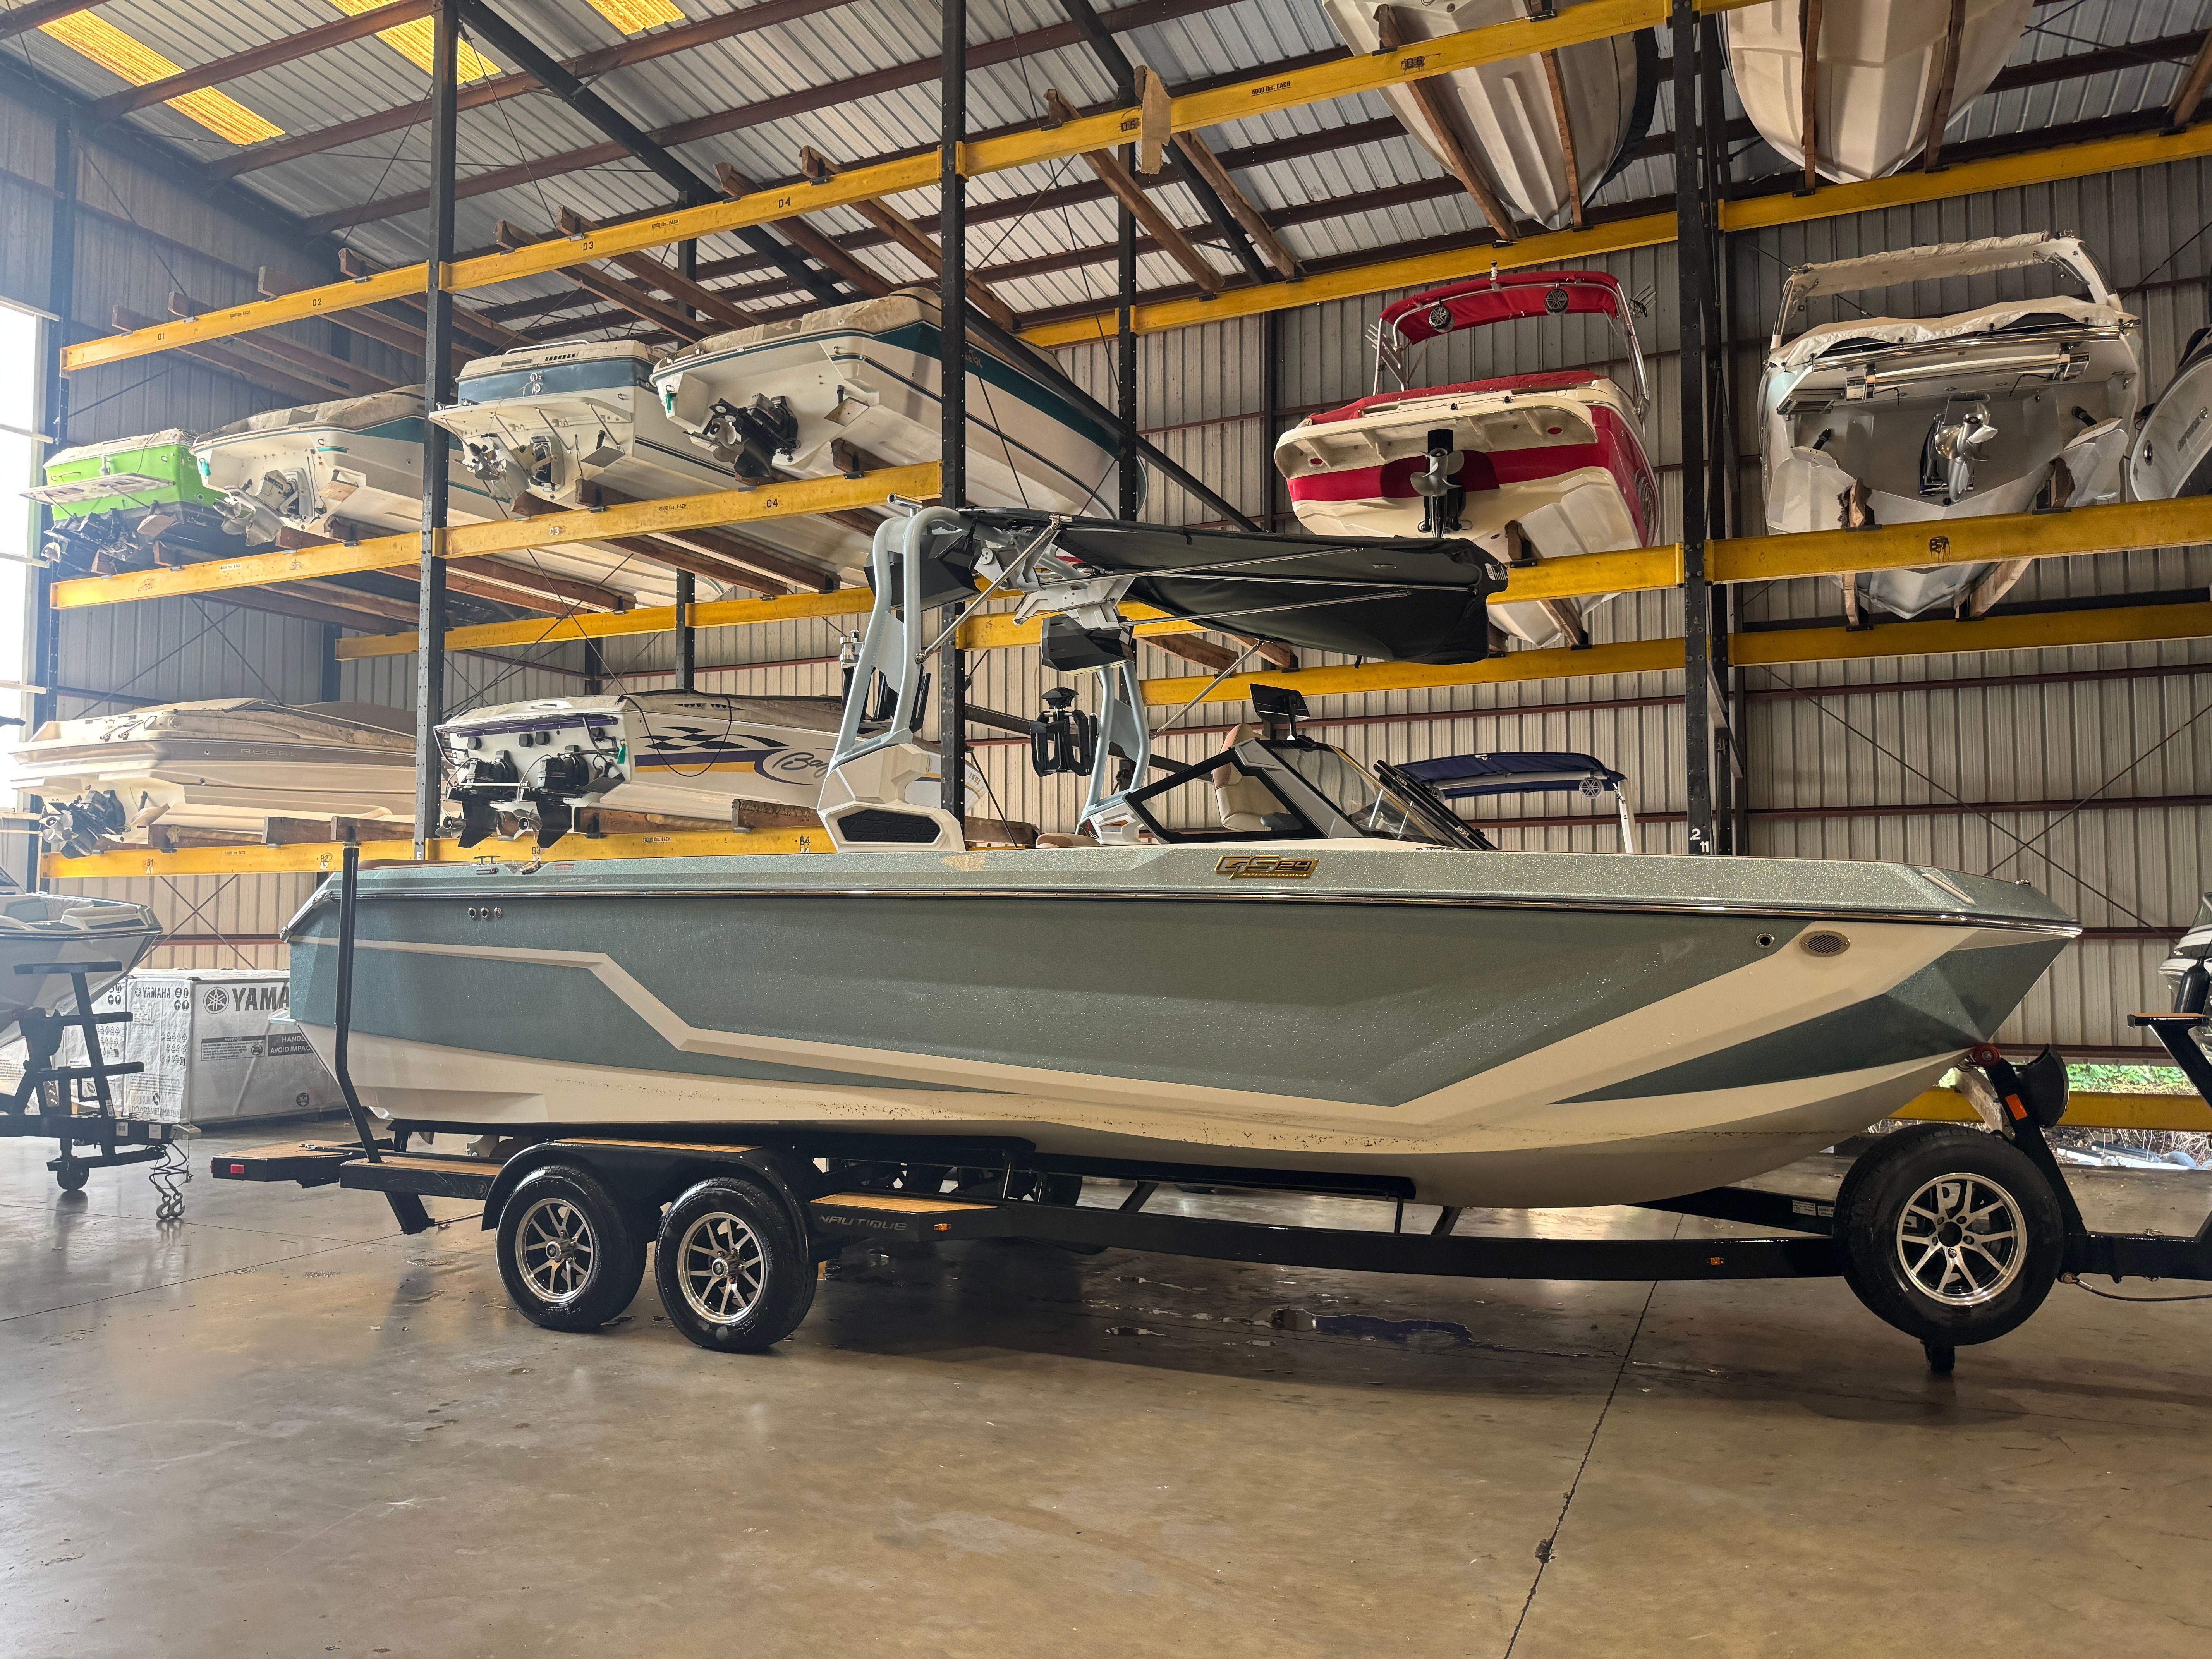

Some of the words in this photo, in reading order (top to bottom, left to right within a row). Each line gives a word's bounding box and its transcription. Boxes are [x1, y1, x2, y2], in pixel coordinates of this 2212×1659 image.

[779, 197, 790, 208] D4
[583, 241, 593, 251] D3
[313, 298, 321, 306] D2
[767, 498, 778, 508] C4
[549, 527, 559, 536] C3
[1700, 841, 1709, 853] 11
[143, 987, 170, 998] YAMAHA
[819, 1215, 907, 1230] NAUTIQUE
